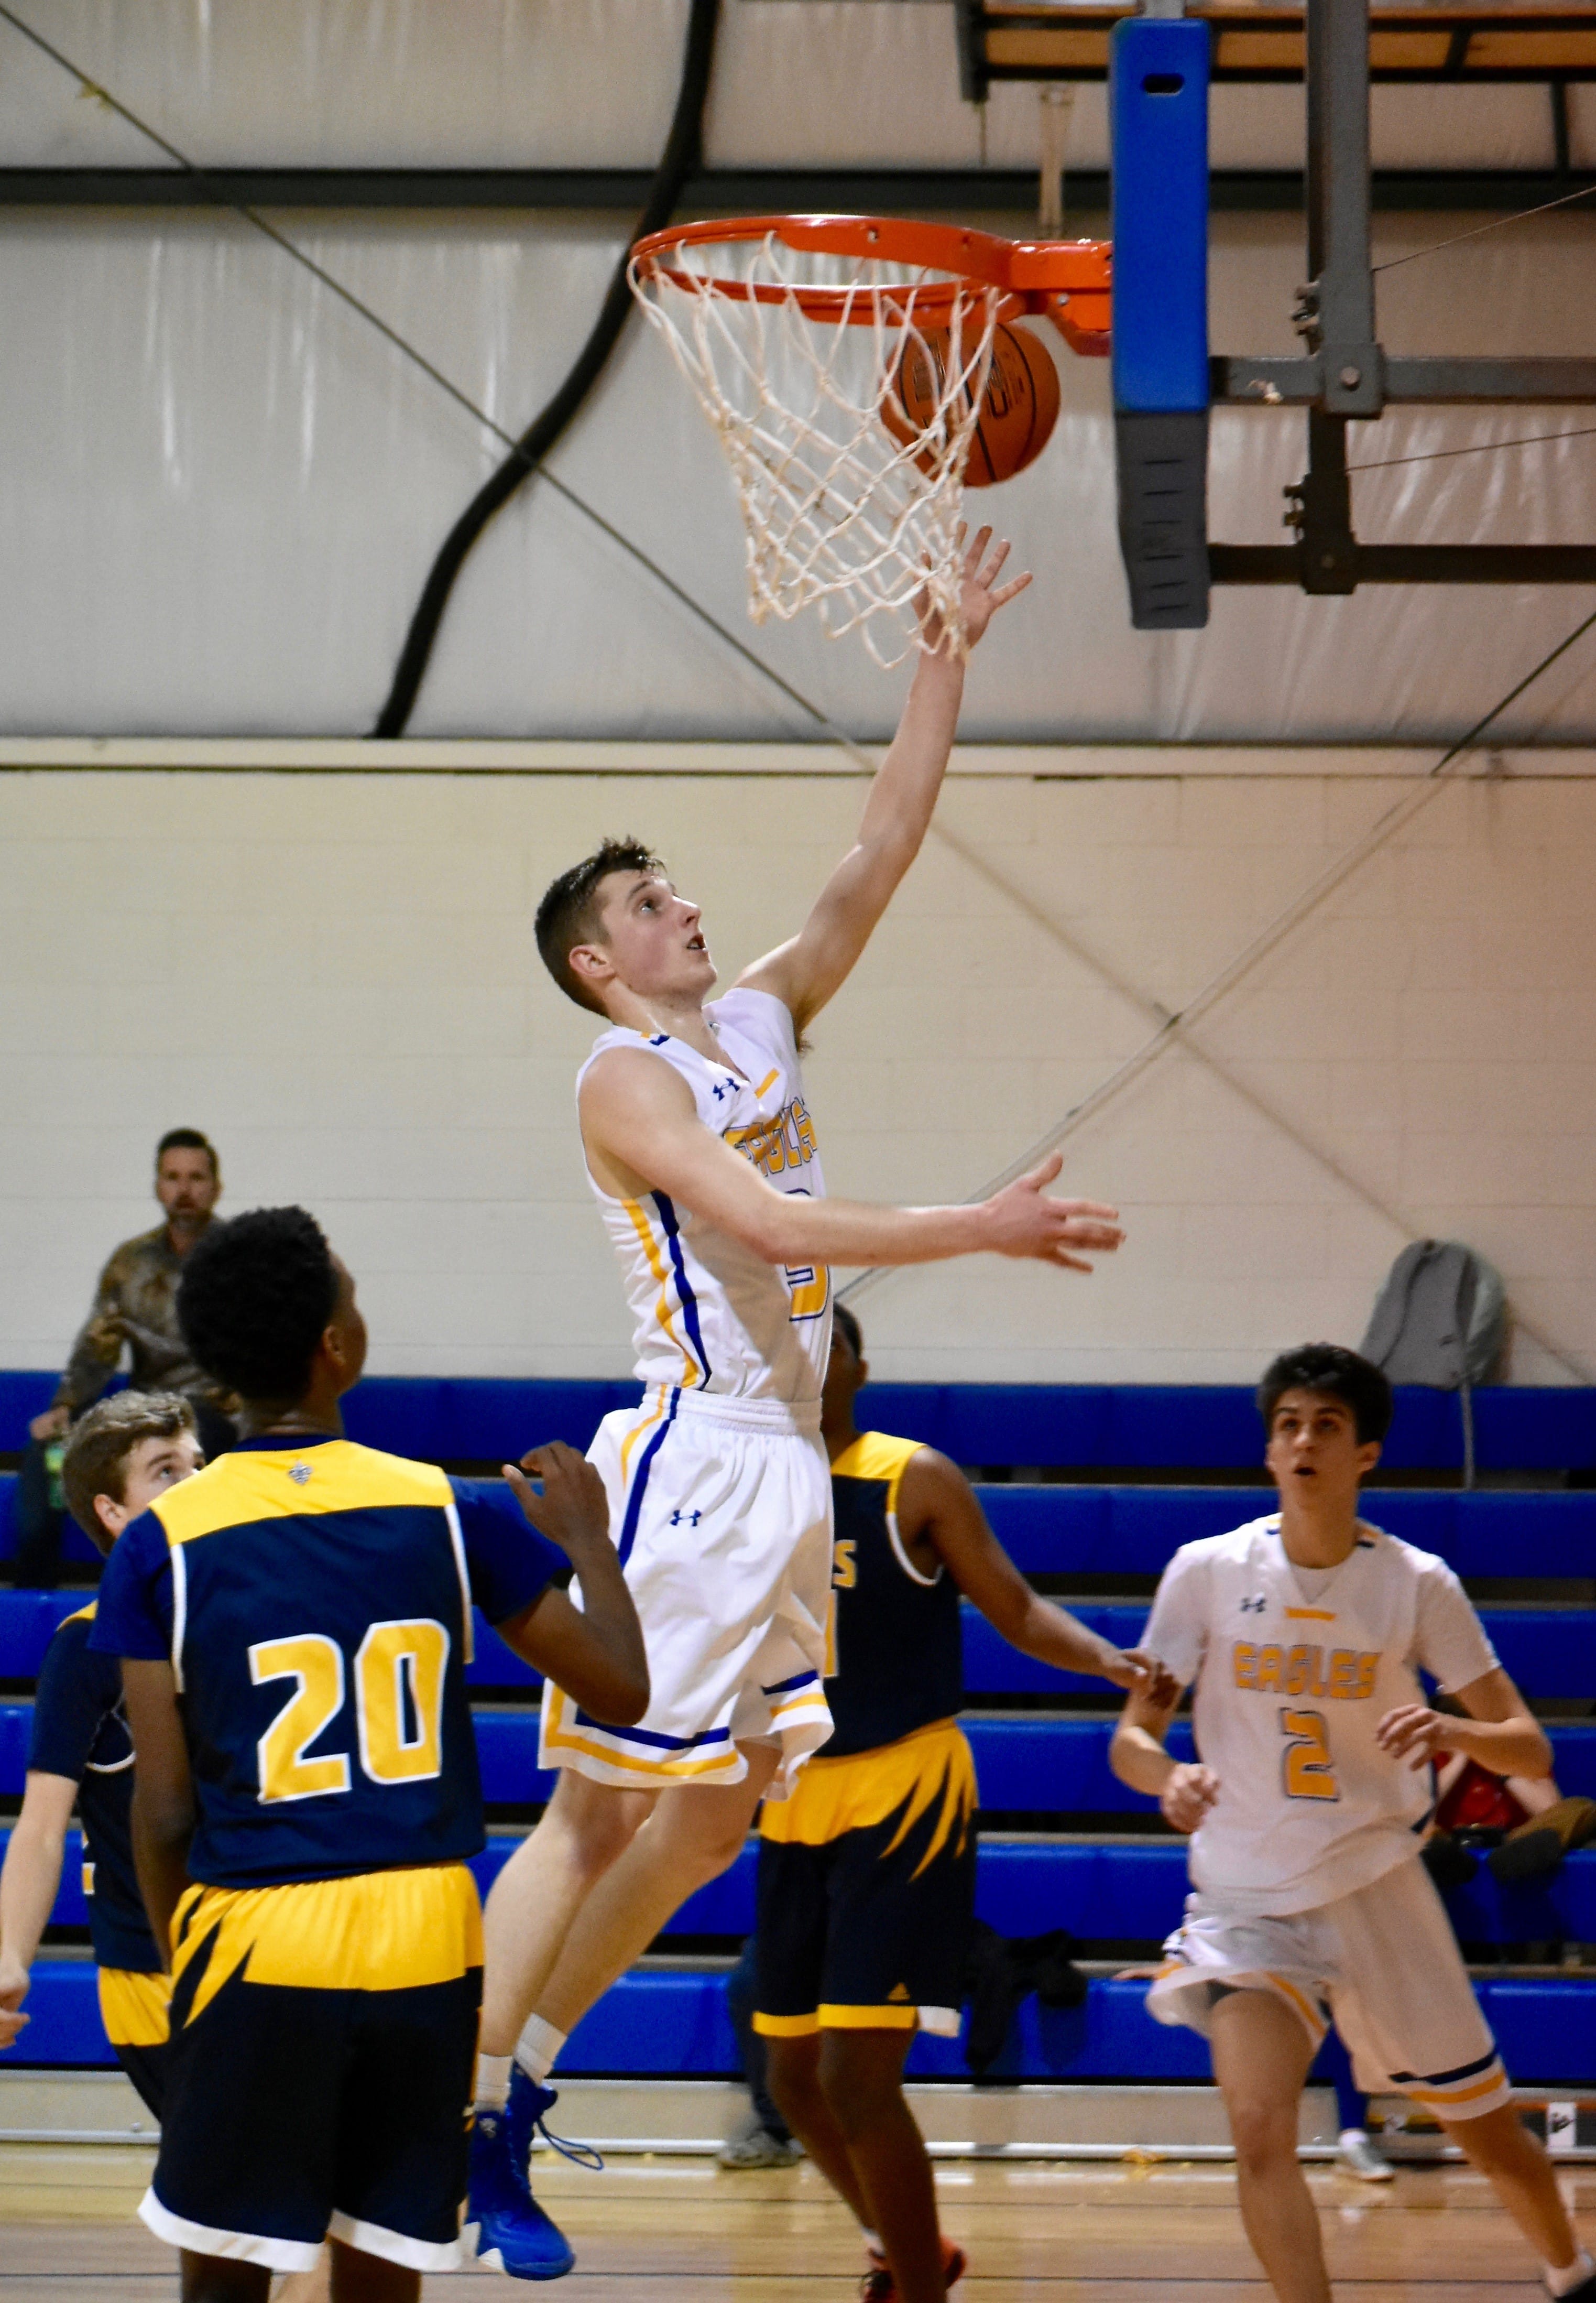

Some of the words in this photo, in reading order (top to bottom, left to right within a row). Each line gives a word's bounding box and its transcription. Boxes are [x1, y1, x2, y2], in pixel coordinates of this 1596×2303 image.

[248, 1617, 450, 1805] 20
[1233, 1640, 1382, 1699] EAGLES
[1280, 1707, 1340, 1802] 2
